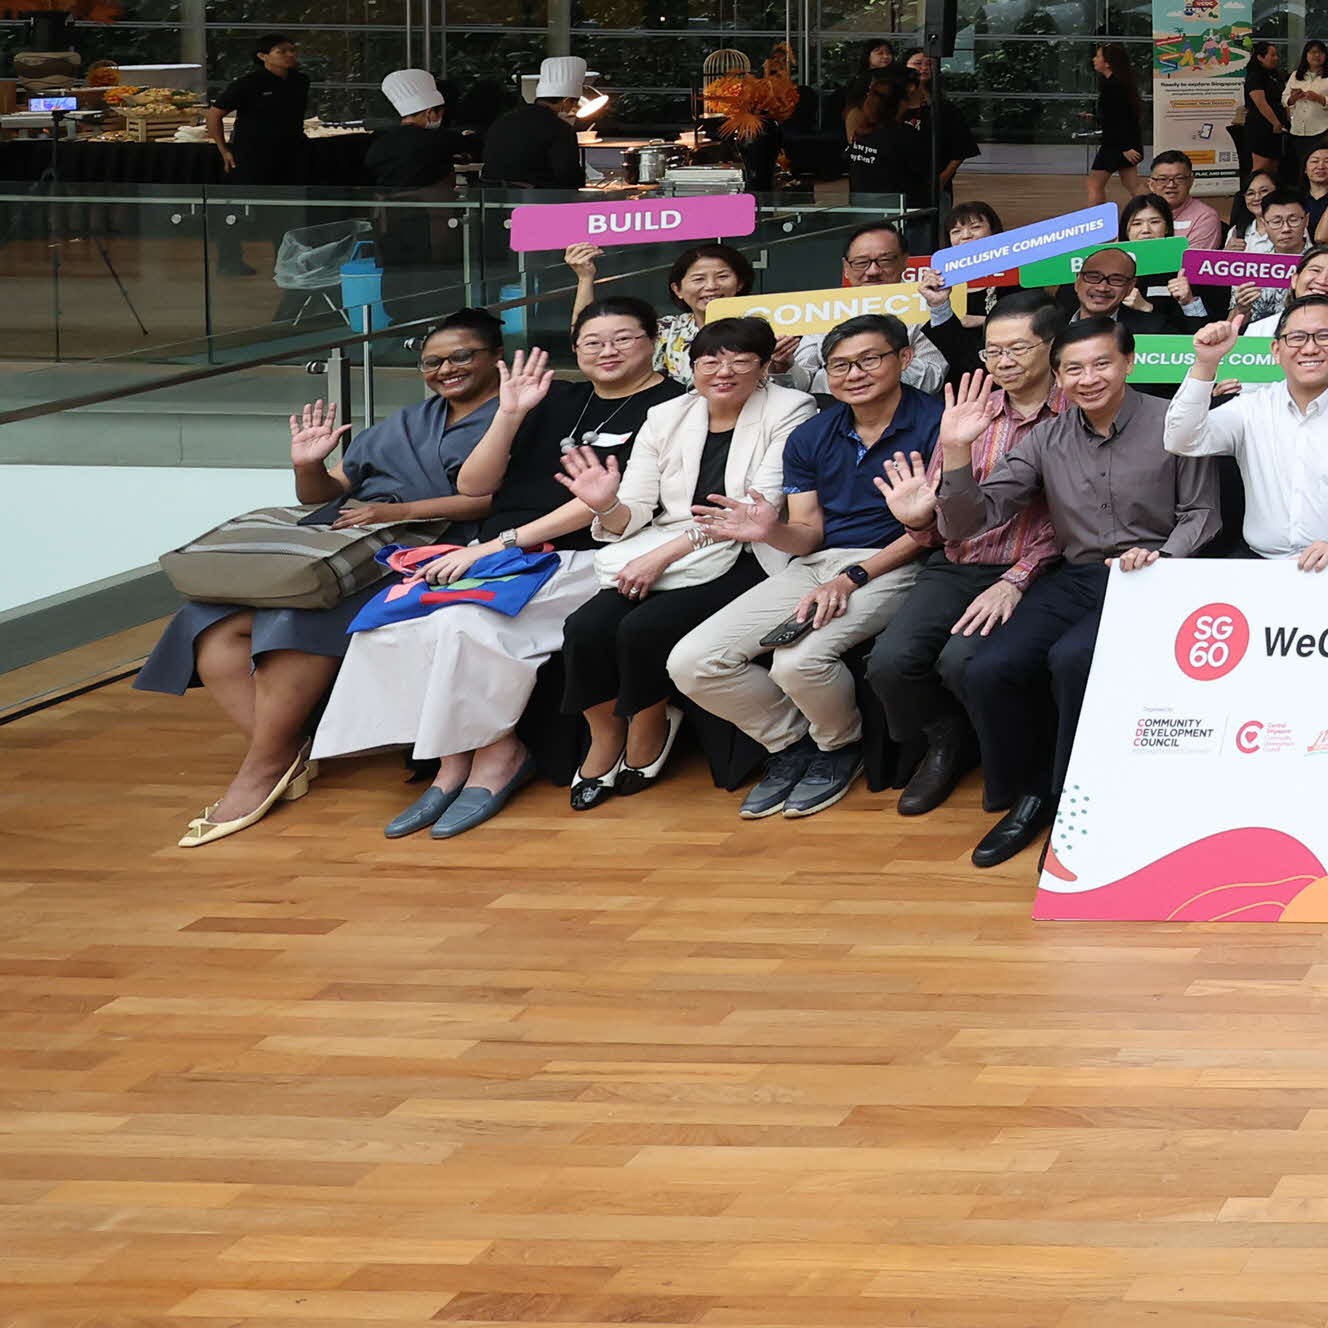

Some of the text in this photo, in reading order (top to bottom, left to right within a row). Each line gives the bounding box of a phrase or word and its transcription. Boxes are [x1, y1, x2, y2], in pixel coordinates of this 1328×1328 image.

[587, 209, 683, 235] BUILD
[944, 219, 1105, 272] INCLUSIVE COMMUNITIES
[1198, 260, 1298, 279] AGGREGA
[1194, 615, 1234, 641] SG
[1188, 641, 1229, 668] 60
[1135, 727, 1214, 738] DEVELOPMENT
[1137, 718, 1202, 728] COMMUNITY
[1133, 737, 1180, 747] COUNCIL
